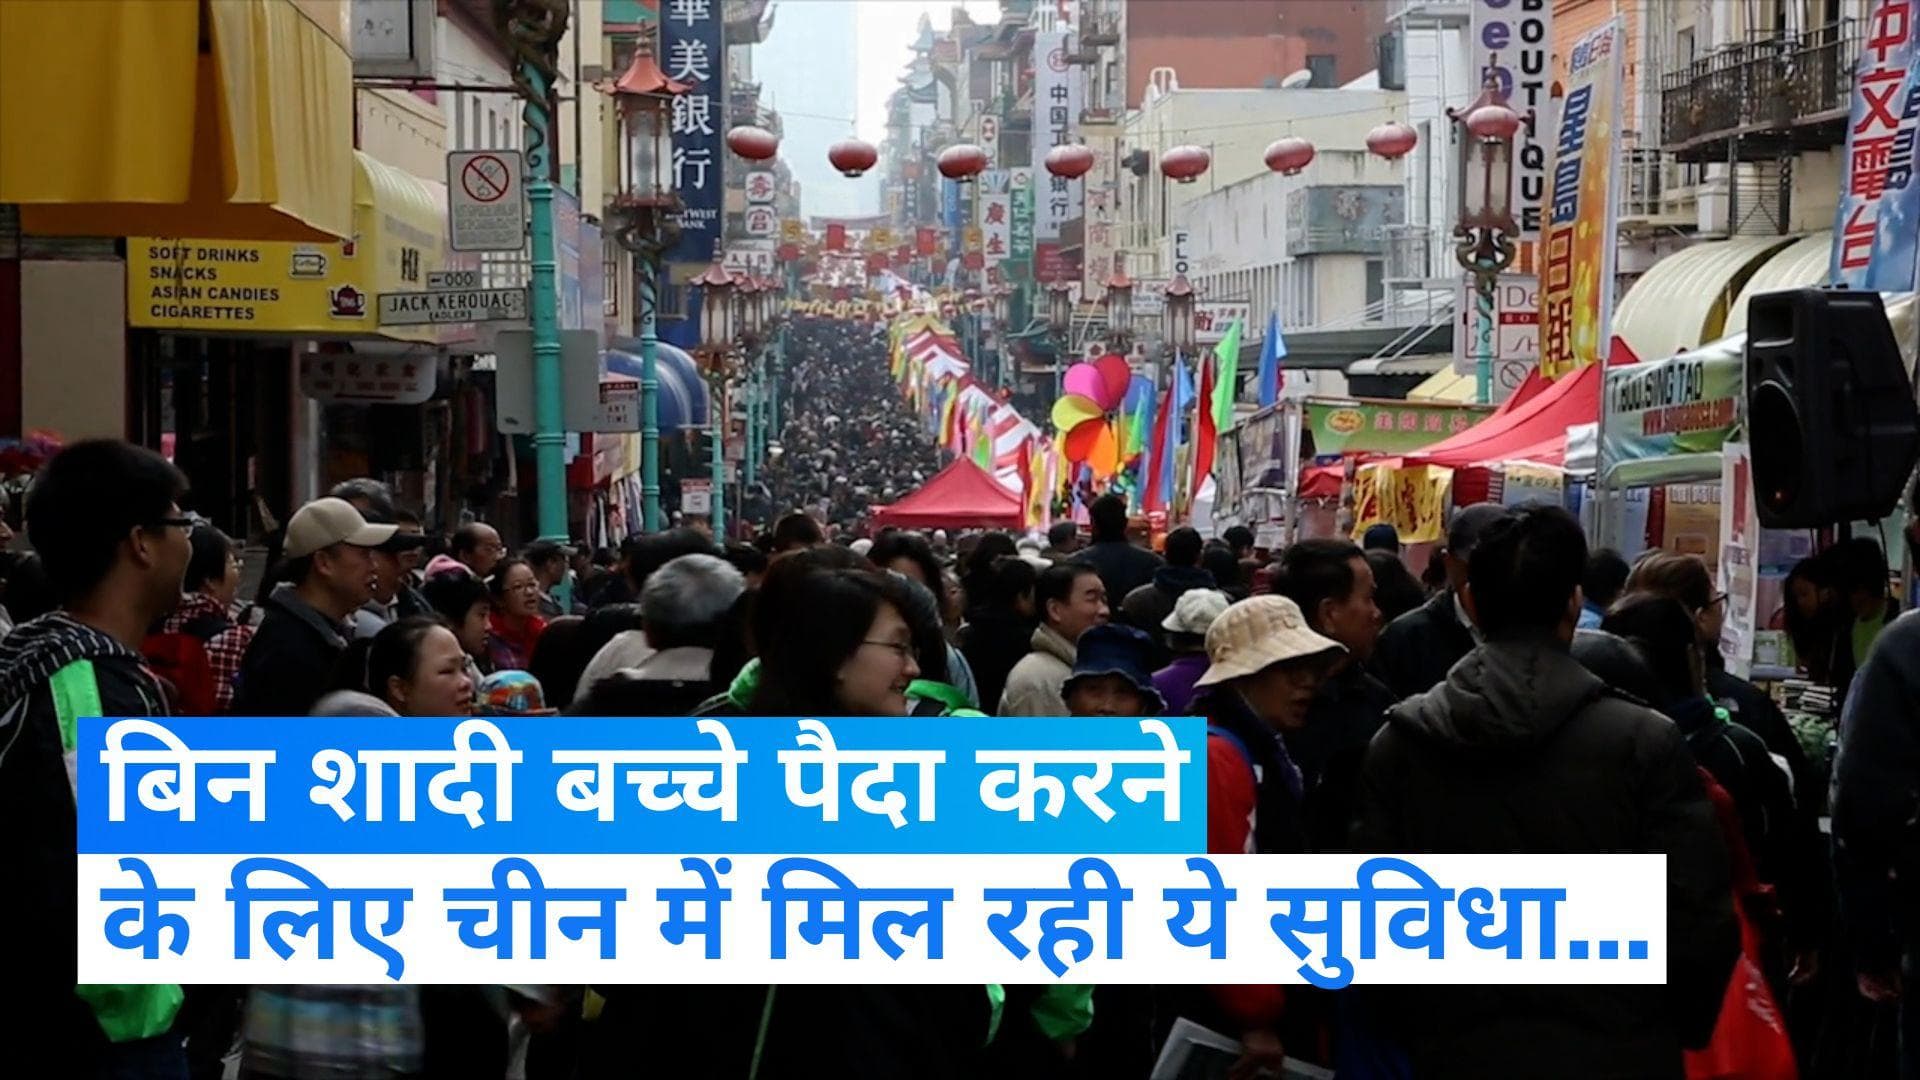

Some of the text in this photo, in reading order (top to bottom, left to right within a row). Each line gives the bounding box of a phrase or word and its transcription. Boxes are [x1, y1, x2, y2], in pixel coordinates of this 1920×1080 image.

[1481, 0, 1513, 104] ep
[669, 0, 715, 190] 華美銀行
[1840, 0, 1910, 270] 中文電台
[150, 246, 260, 262] SOFT DRINKS
[150, 266, 218, 281] SNACKS
[152, 286, 280, 302] ASIAN CANDIES
[389, 292, 512, 312] JACK KEROUAC
[151, 304, 256, 320] CIGARETTES
